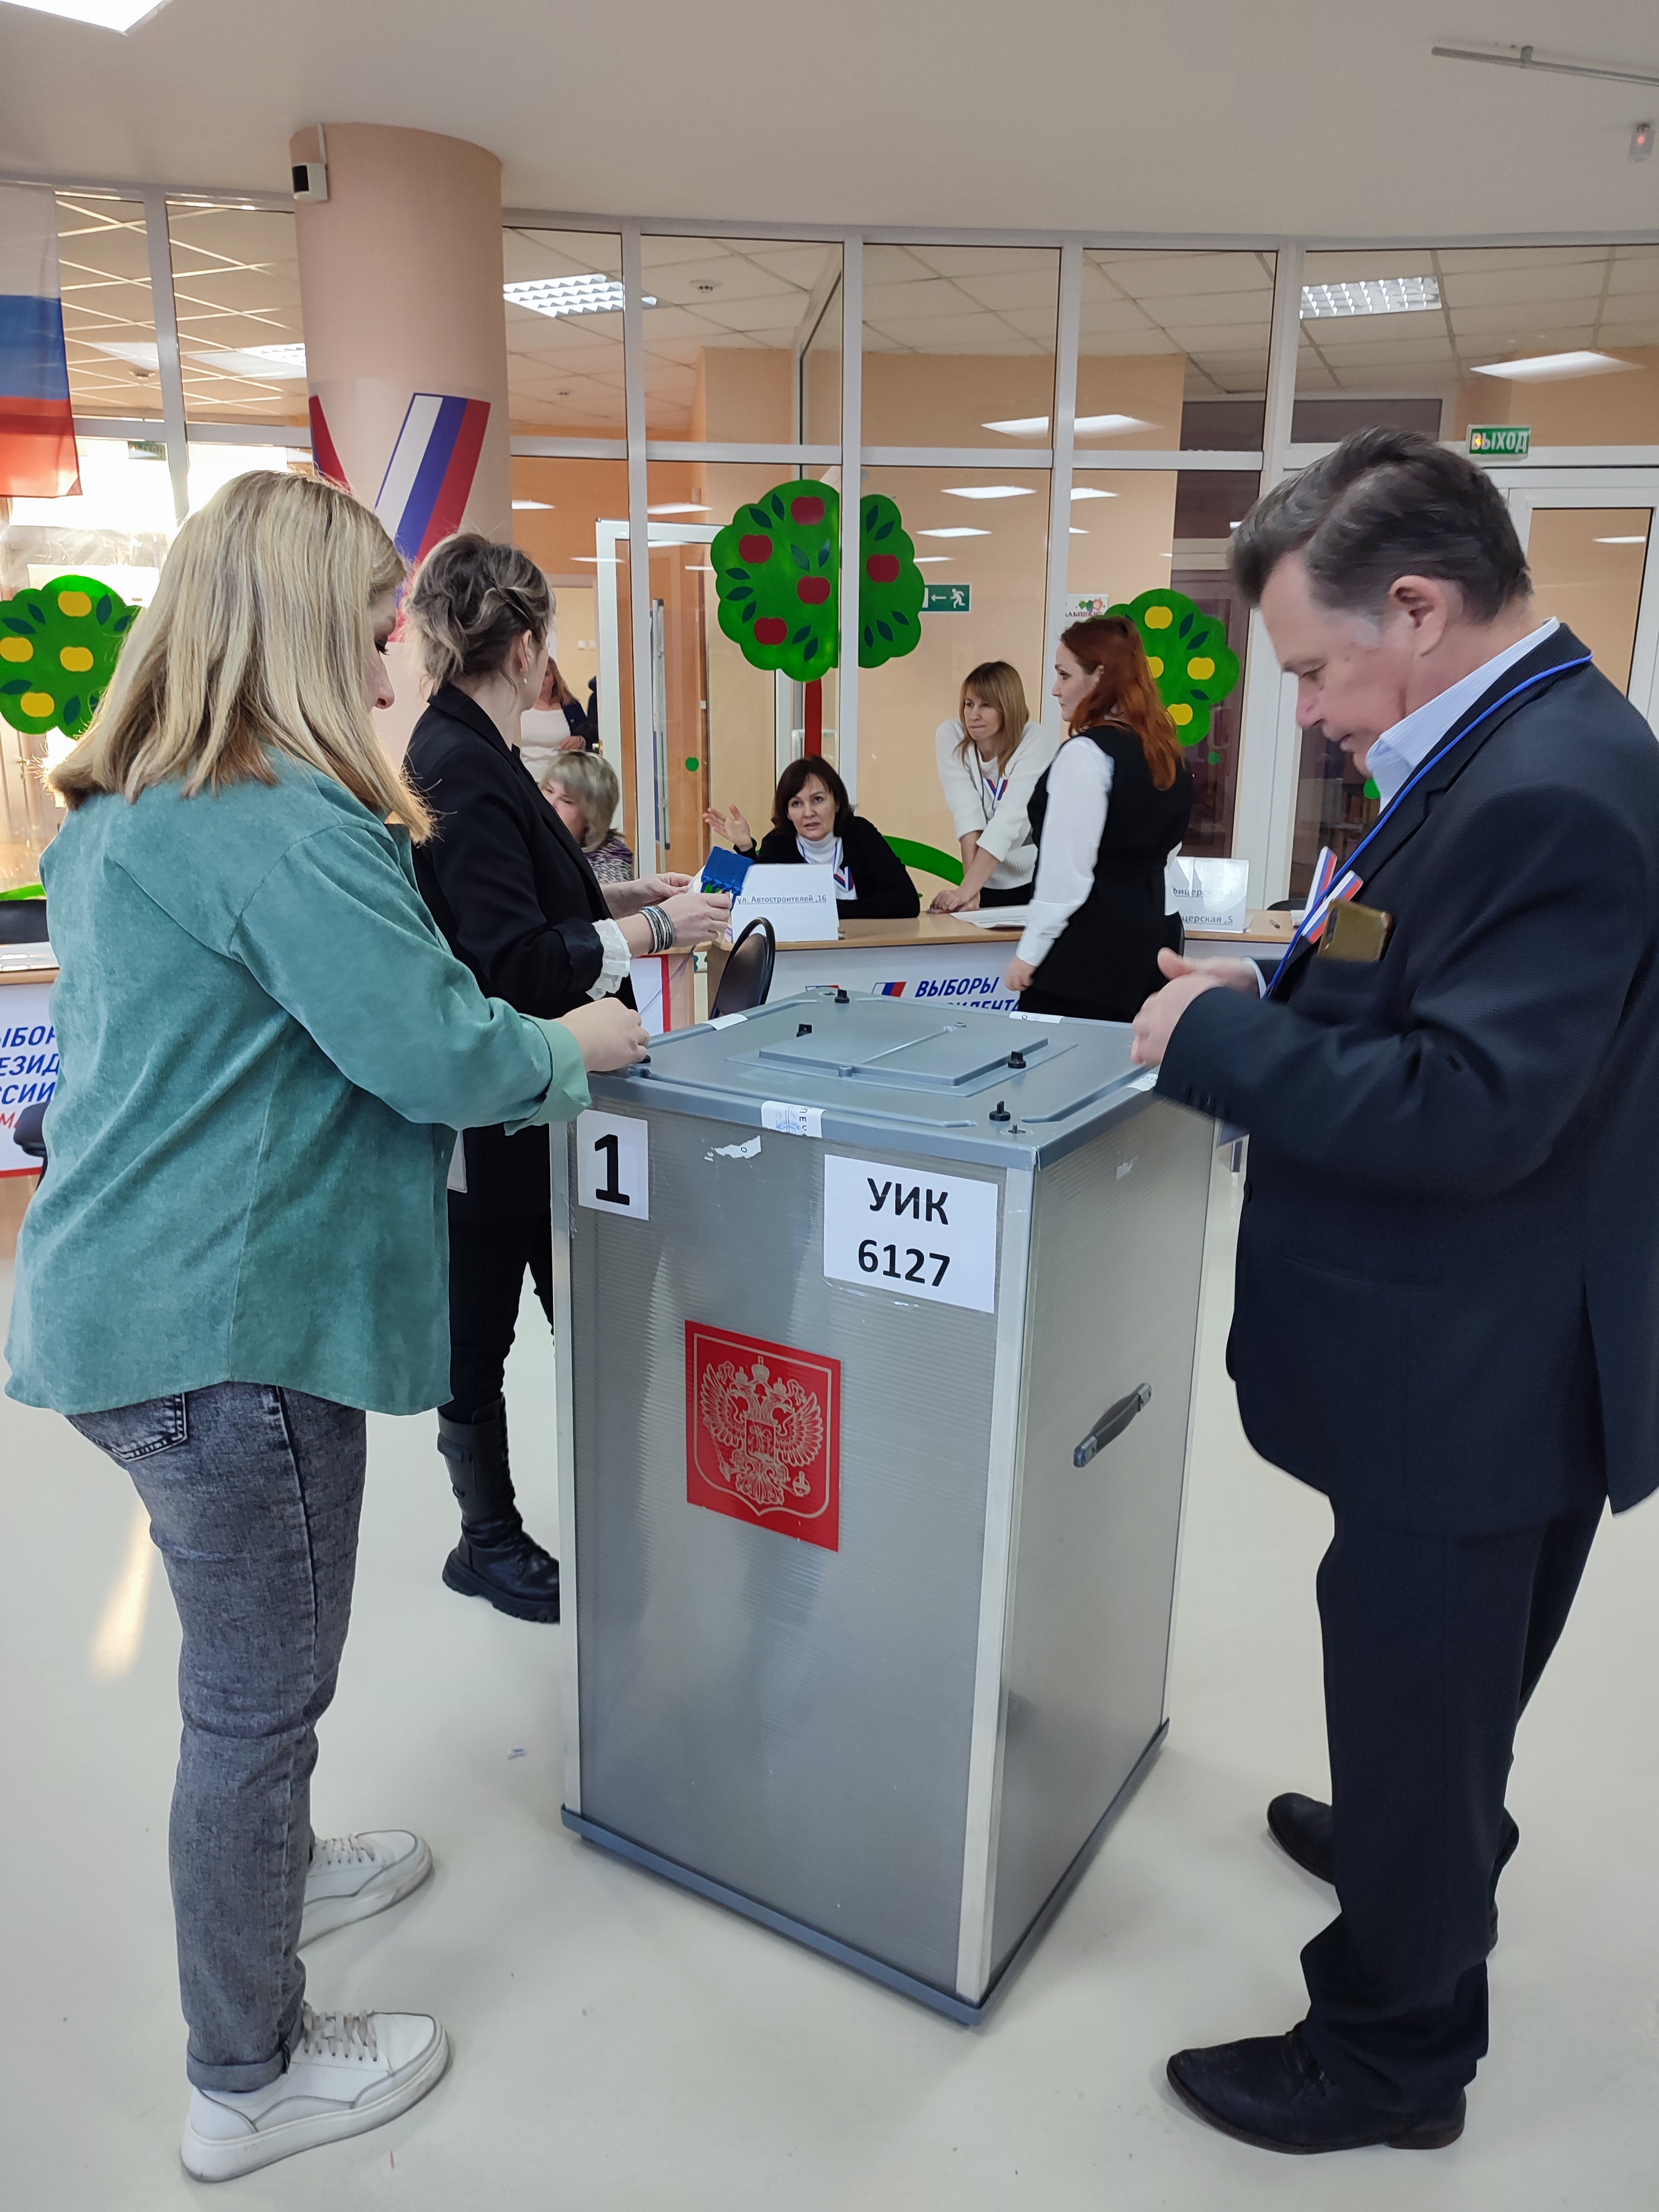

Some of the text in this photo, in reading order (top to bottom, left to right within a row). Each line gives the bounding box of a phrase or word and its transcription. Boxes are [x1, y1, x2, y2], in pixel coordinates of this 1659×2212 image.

[1471, 431, 1528, 452] ВЫХОД
[752, 895, 813, 904] Автостроителей
[915, 977, 1000, 998] ВЫБОРЫ
[0, 1082, 56, 1104] СИИ
[594, 1134, 630, 1206] 1
[867, 1177, 950, 1225] УИК
[858, 1239, 951, 1287] 6127
